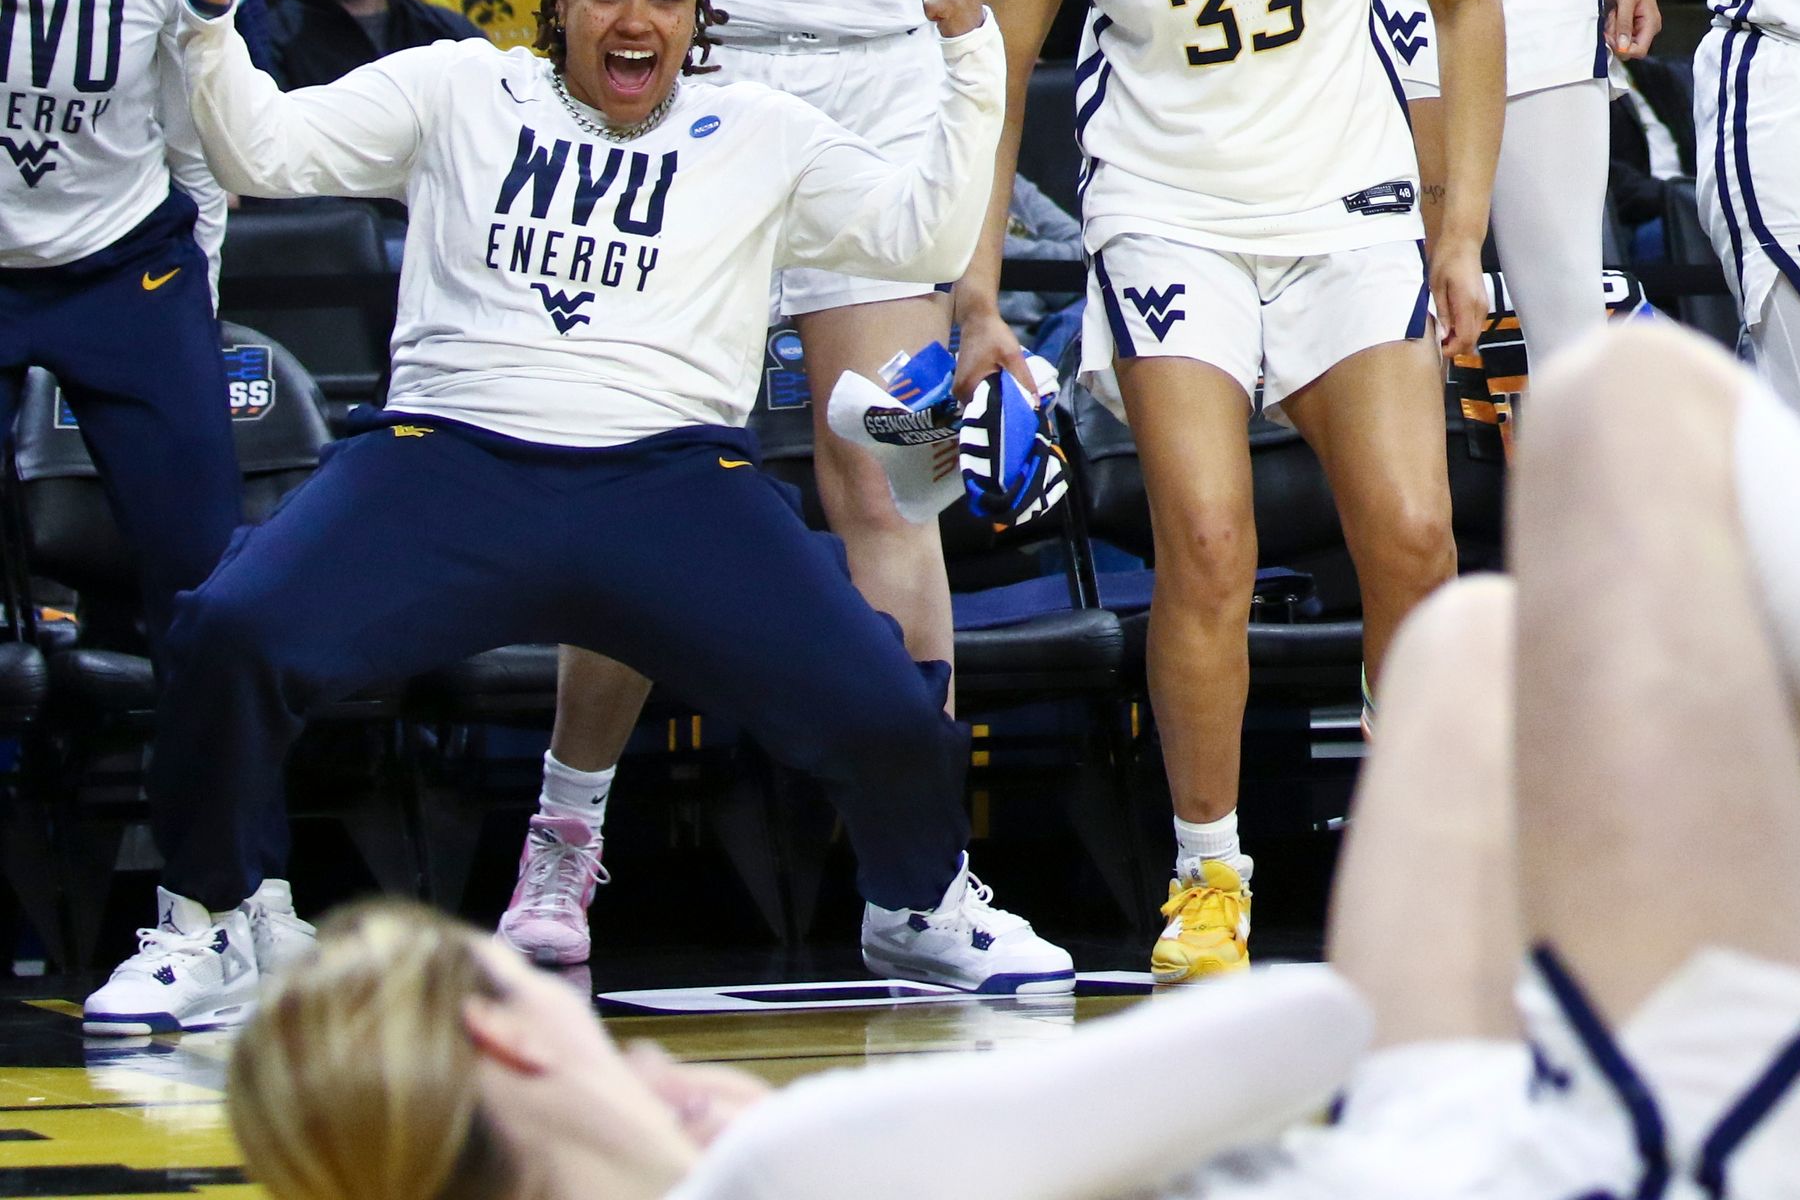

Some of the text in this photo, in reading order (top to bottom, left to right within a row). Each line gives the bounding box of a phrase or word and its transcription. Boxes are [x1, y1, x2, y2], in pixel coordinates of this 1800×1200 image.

[7, 94, 111, 135] ERGY
[491, 126, 678, 239] WVU
[1399, 187, 1412, 198] 48
[486, 221, 660, 293] ENERGY
[866, 407, 934, 435] MADNESS
